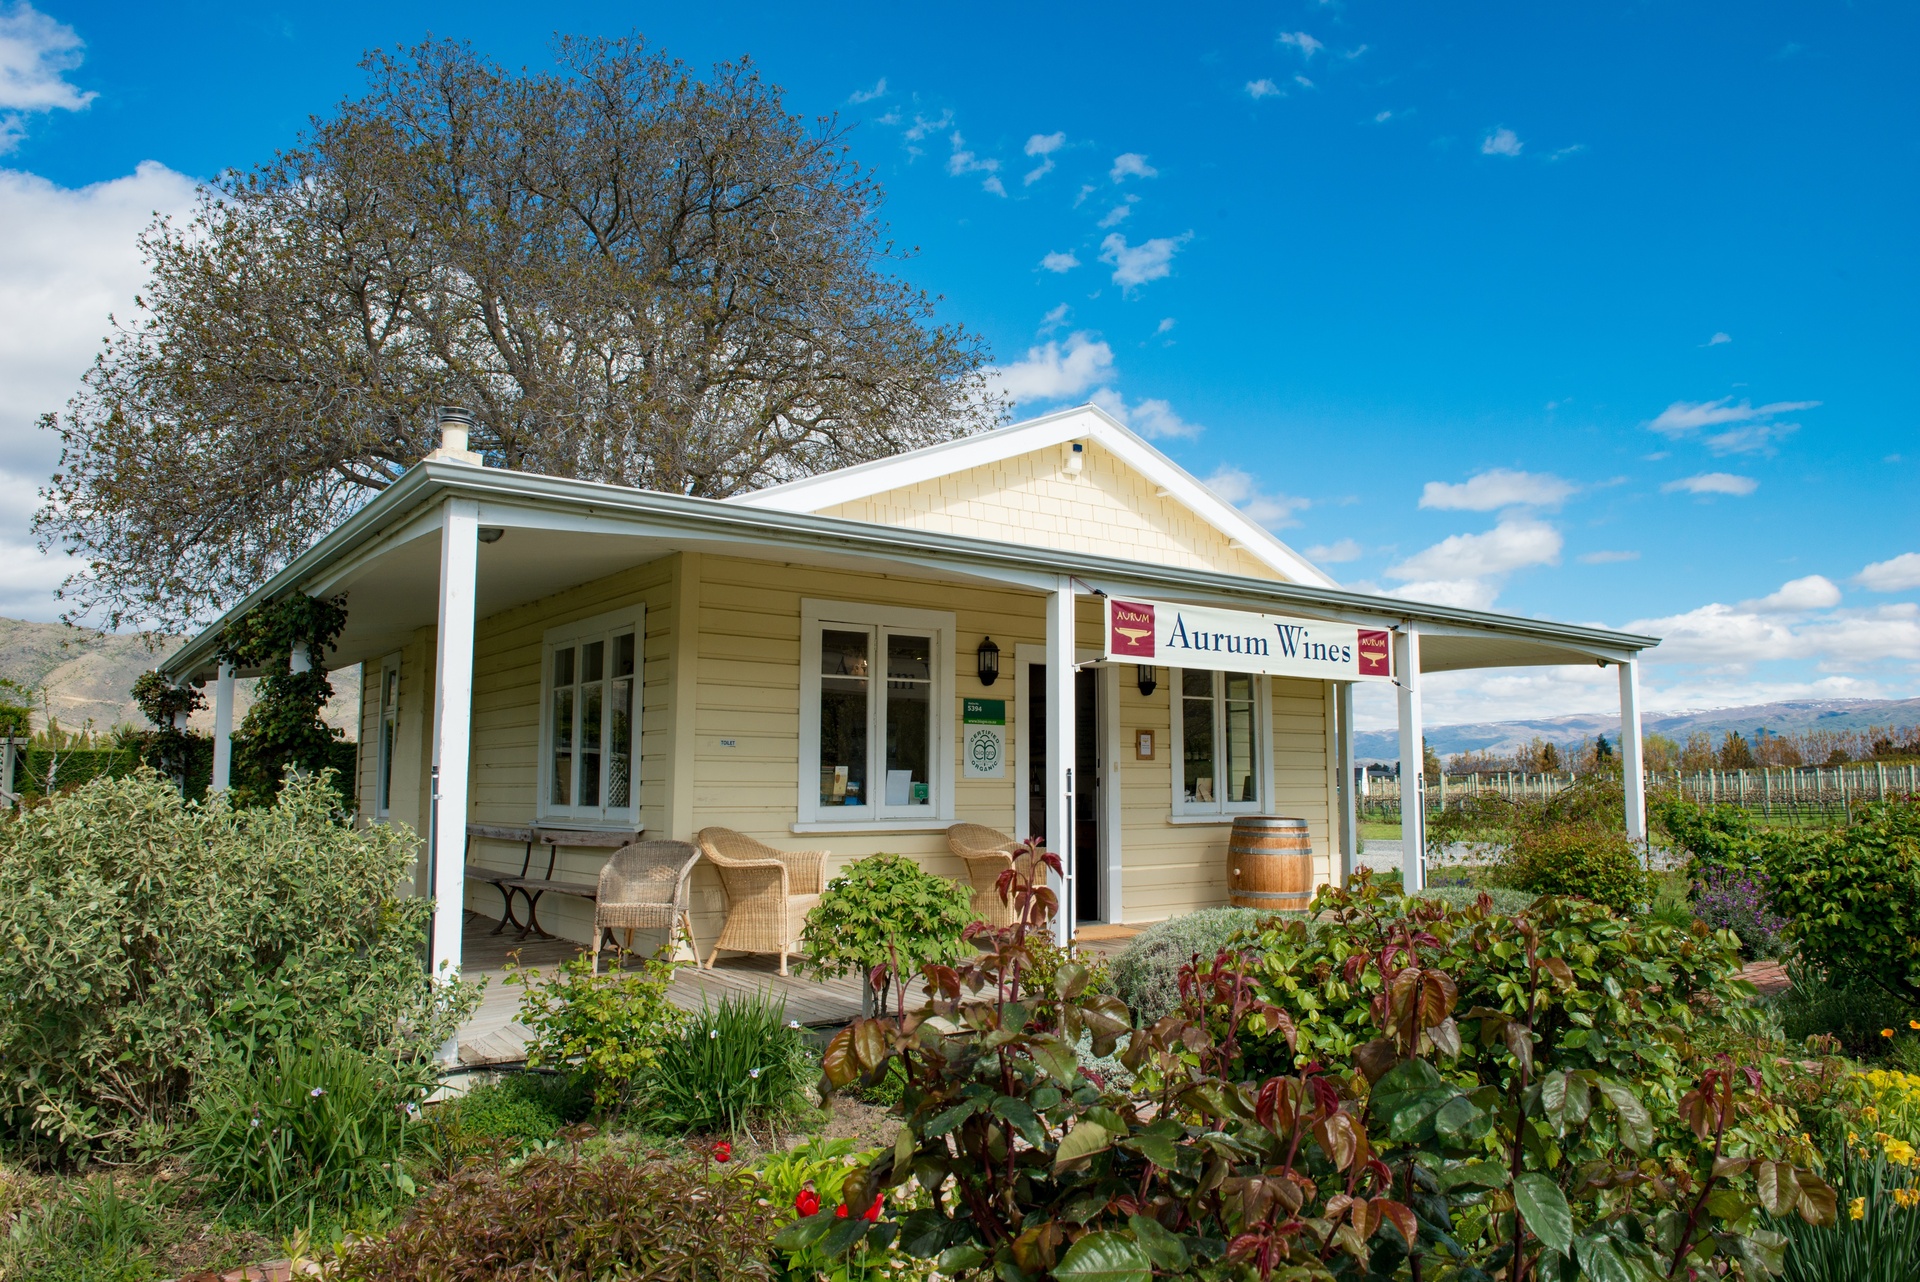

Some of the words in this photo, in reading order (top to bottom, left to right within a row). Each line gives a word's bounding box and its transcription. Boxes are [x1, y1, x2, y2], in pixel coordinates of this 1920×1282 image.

[1116, 611, 1150, 624] AURUM
[1166, 612, 1269, 656] Aurum
[1274, 623, 1351, 663] Wines
[1361, 638, 1385, 647] AURUM
[970, 730, 1000, 744] CERTIFIED
[971, 760, 998, 772] ORGANIC
